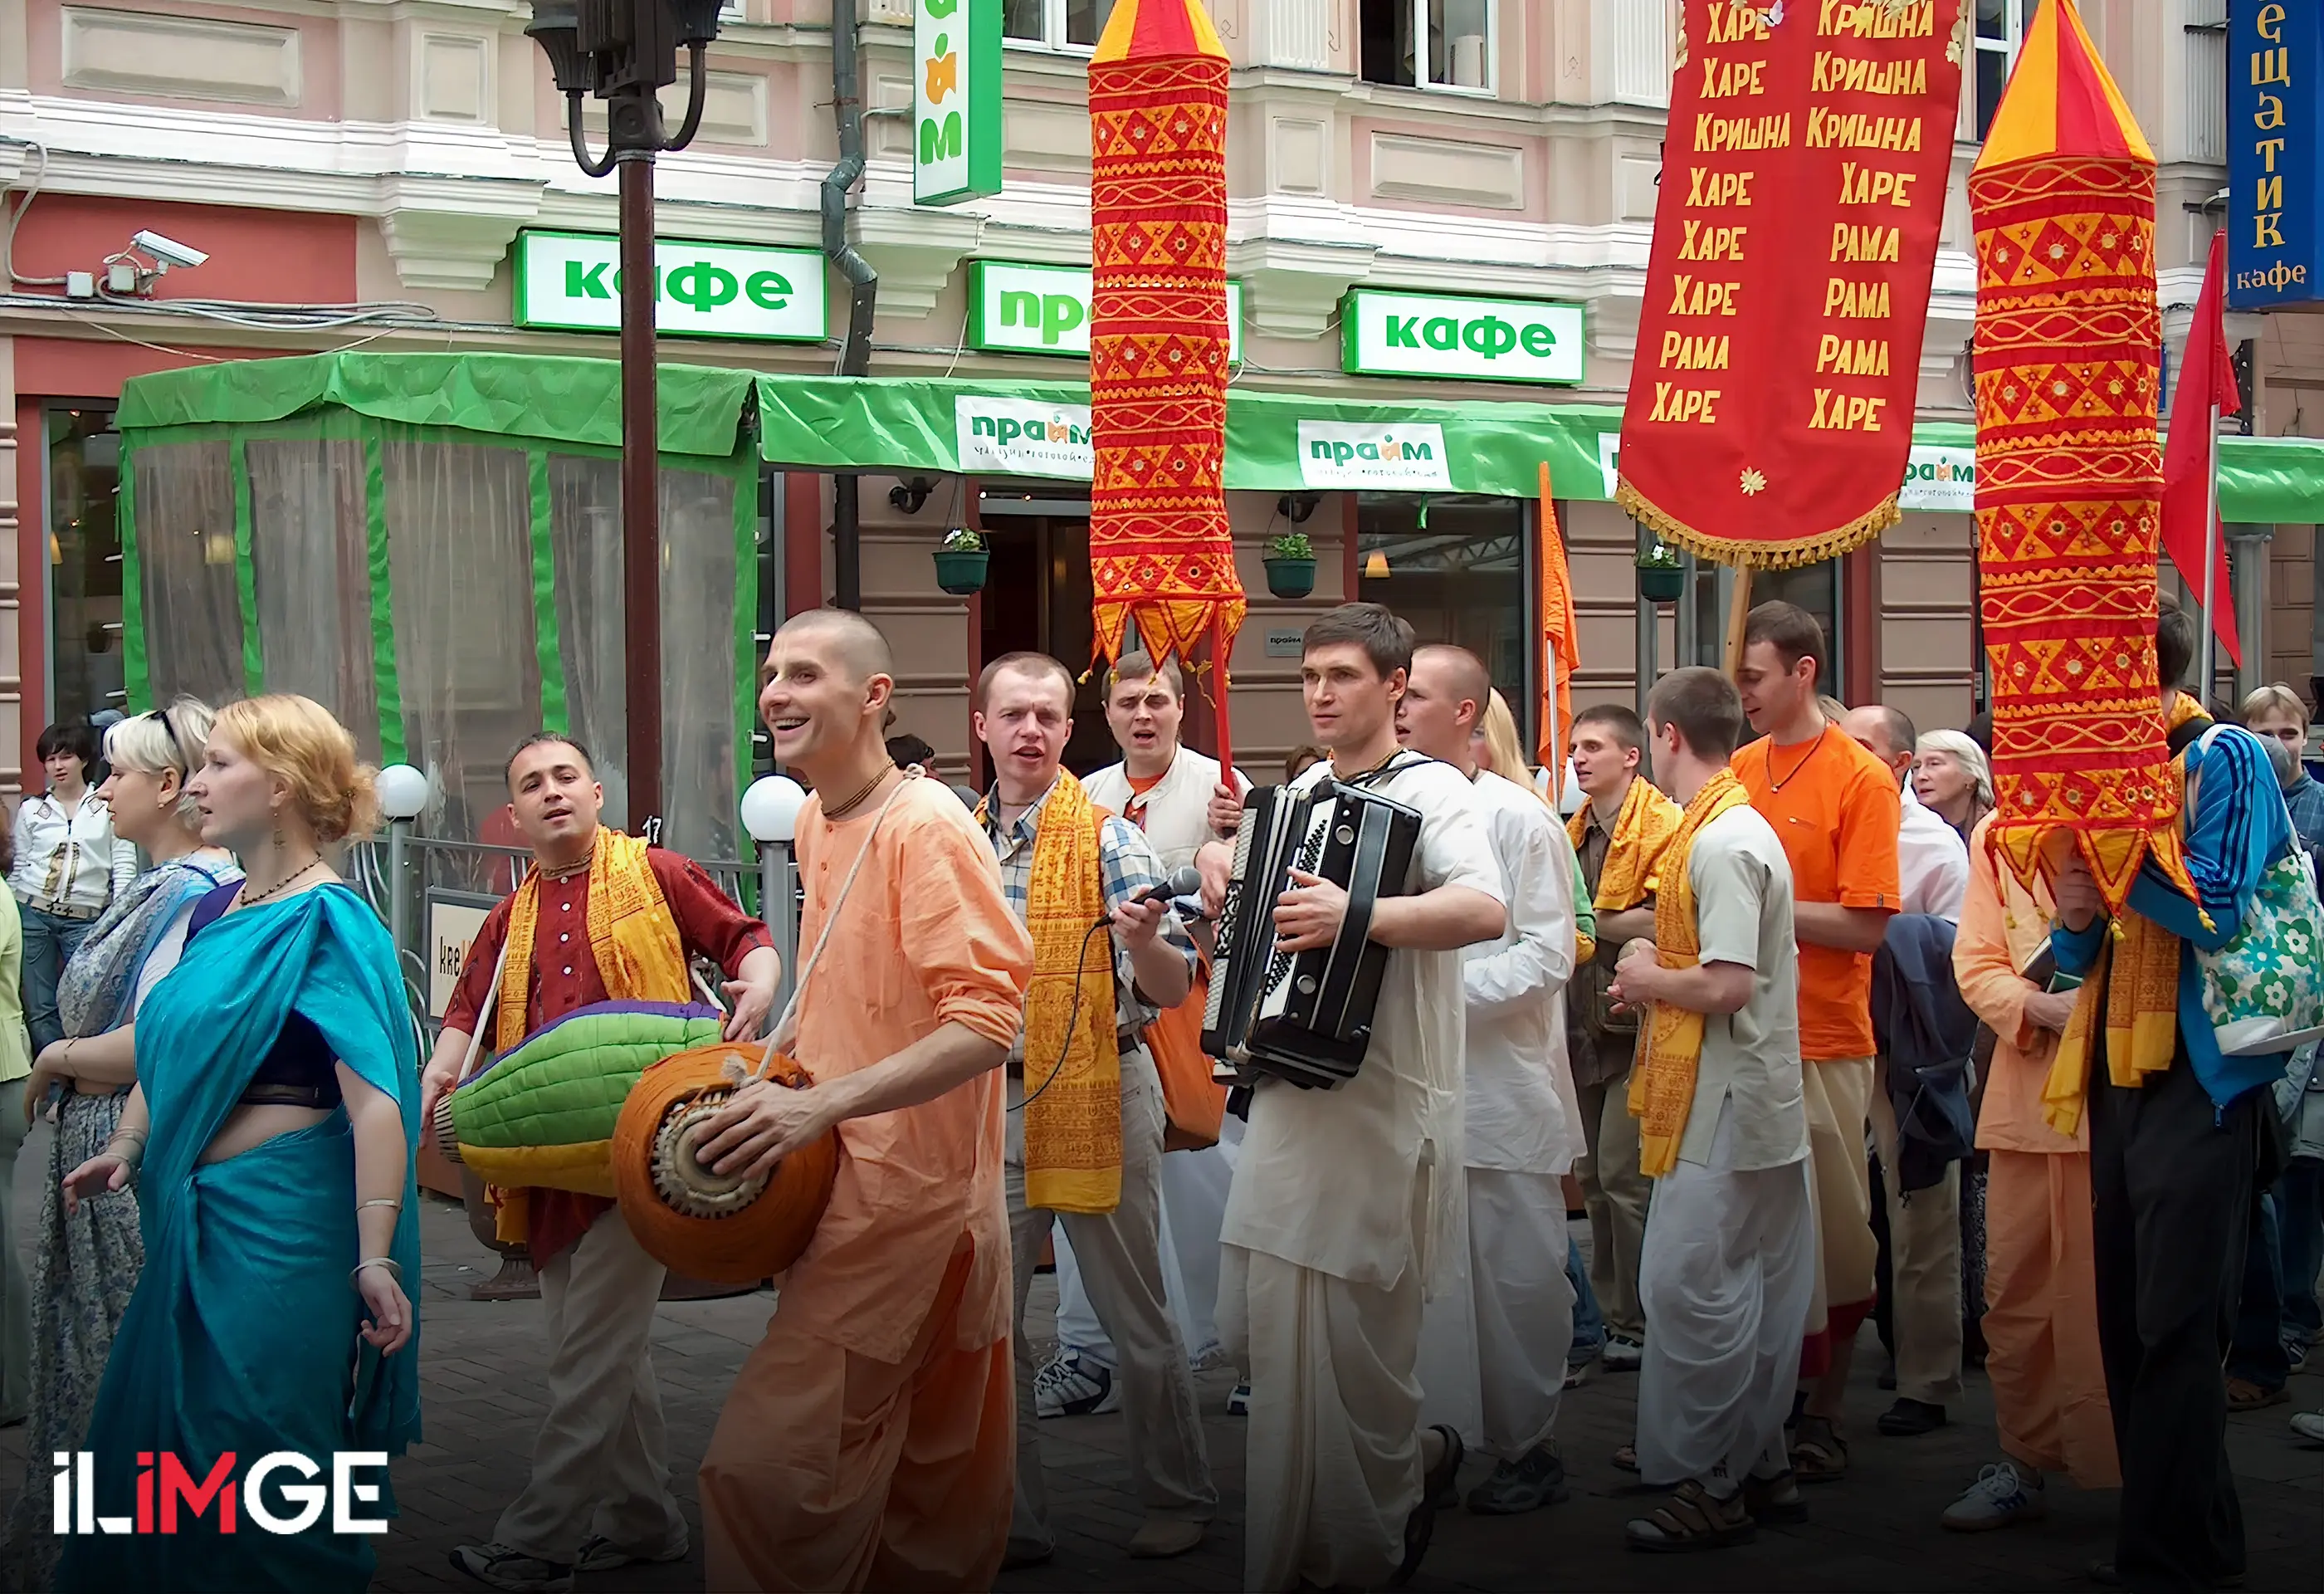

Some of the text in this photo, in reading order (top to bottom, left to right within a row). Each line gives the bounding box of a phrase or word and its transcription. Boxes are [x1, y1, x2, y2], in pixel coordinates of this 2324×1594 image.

[1700, 51, 1926, 99] ХАРЕ КРИШНА
[1693, 106, 1921, 152] КРИШНА КРИШНА
[2251, 0, 2291, 248] ещатик
[1685, 162, 1916, 207] ХАРЕ ХАРЕ
[1677, 219, 1899, 262] ХАРЕ РАМА
[1667, 274, 1891, 318] ХАРЕ РАМА
[2237, 260, 2307, 292] кафе
[1386, 315, 1556, 359] кафе
[1659, 330, 1889, 376] РАМА РАМА
[1648, 382, 1887, 432] ХАРЕ ХАРЕ
[972, 415, 1092, 445] прайм
[1311, 434, 1433, 467] прайм
[1902, 457, 1974, 487] райм
[642, 814, 662, 844] 17
